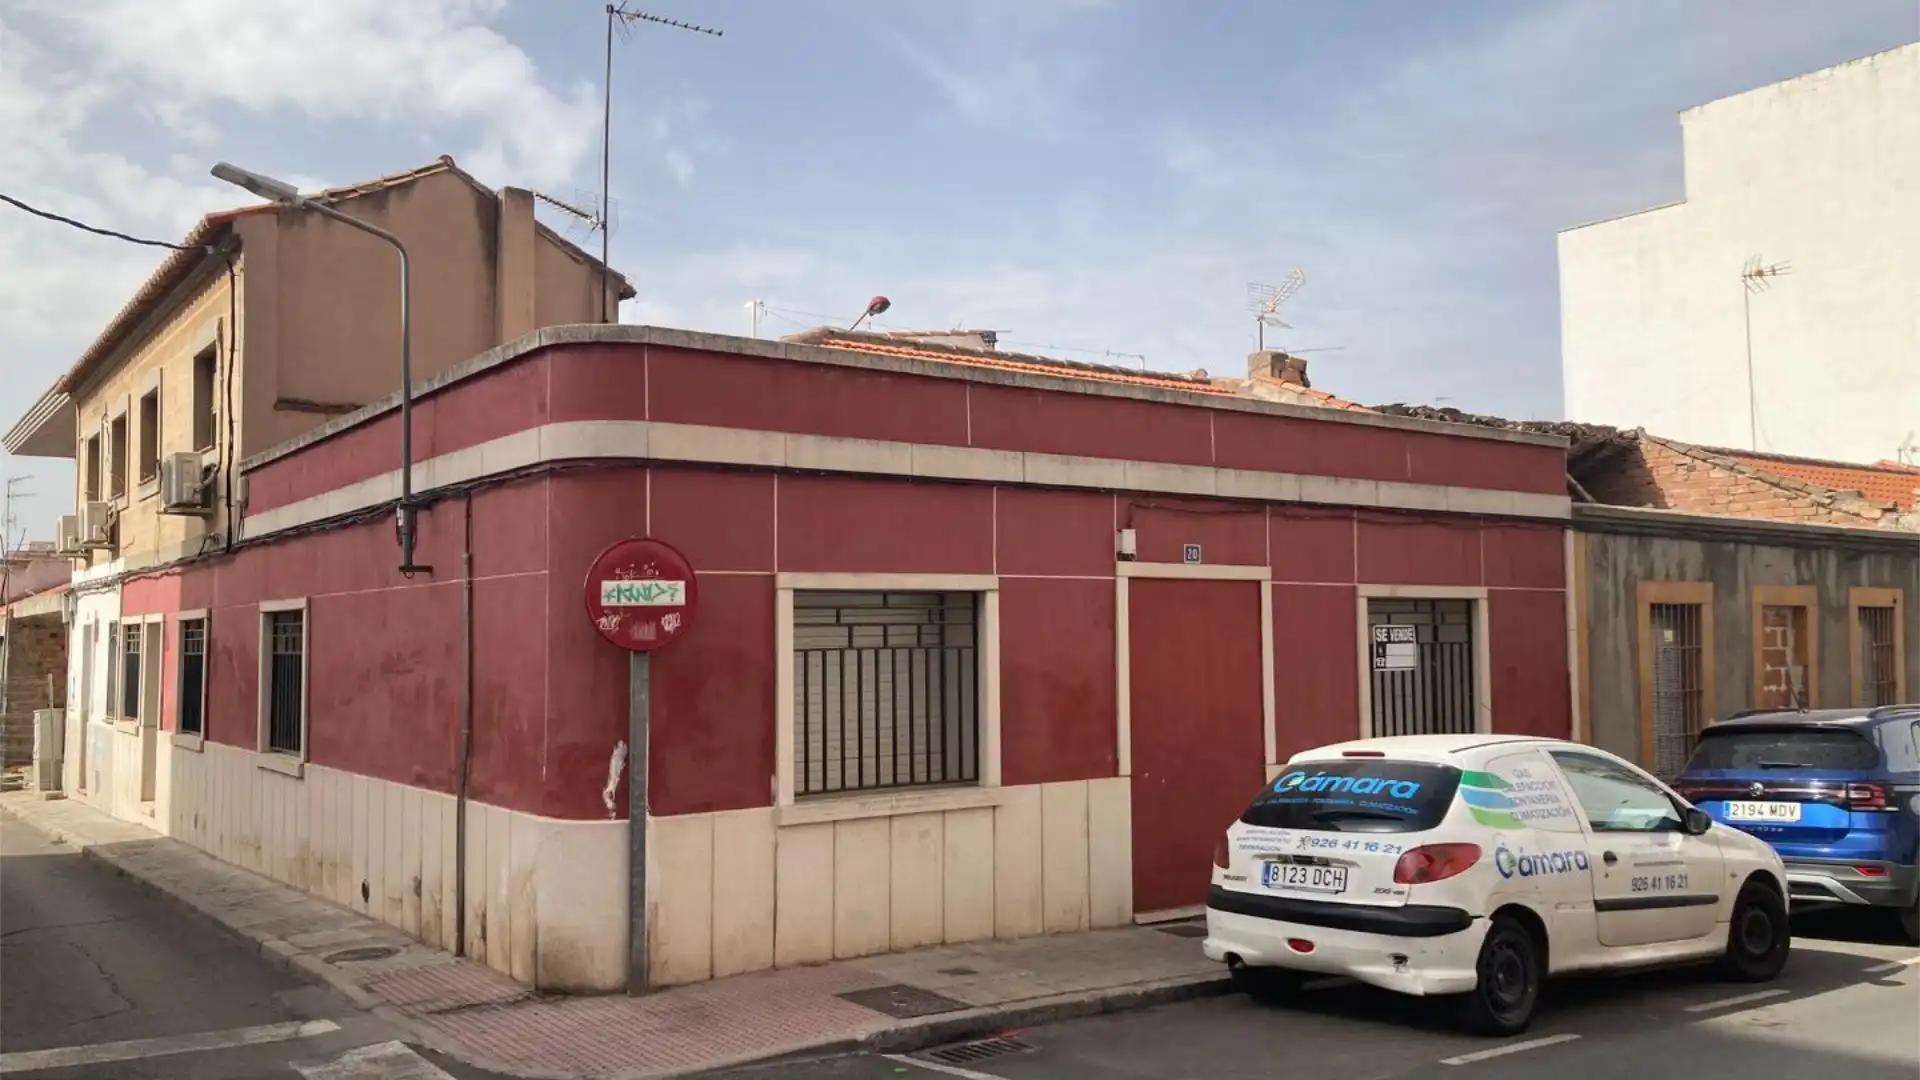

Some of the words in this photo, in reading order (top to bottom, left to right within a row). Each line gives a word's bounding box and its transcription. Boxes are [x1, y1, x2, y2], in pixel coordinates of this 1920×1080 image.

[1187, 548, 1198, 560] 20
[1375, 628, 1388, 642] SE
[1389, 628, 1414, 642] VENDE
[1512, 767, 1532, 779] GAS
[1273, 771, 1421, 800] Cámara
[1732, 804, 1764, 817] 2194
[1770, 804, 1797, 817] MDV
[1311, 837, 1338, 849] 926
[1342, 839, 1360, 851] 41
[1364, 840, 1380, 852] 16
[1383, 843, 1403, 855] 21
[1494, 843, 1589, 880] Cámara
[1271, 864, 1307, 885] 8123
[1313, 868, 1343, 888] DCH
[1631, 876, 1649, 893] 926
[1652, 875, 1662, 891] 41
[1665, 874, 1676, 890] 16
[1677, 872, 1689, 889] 21
